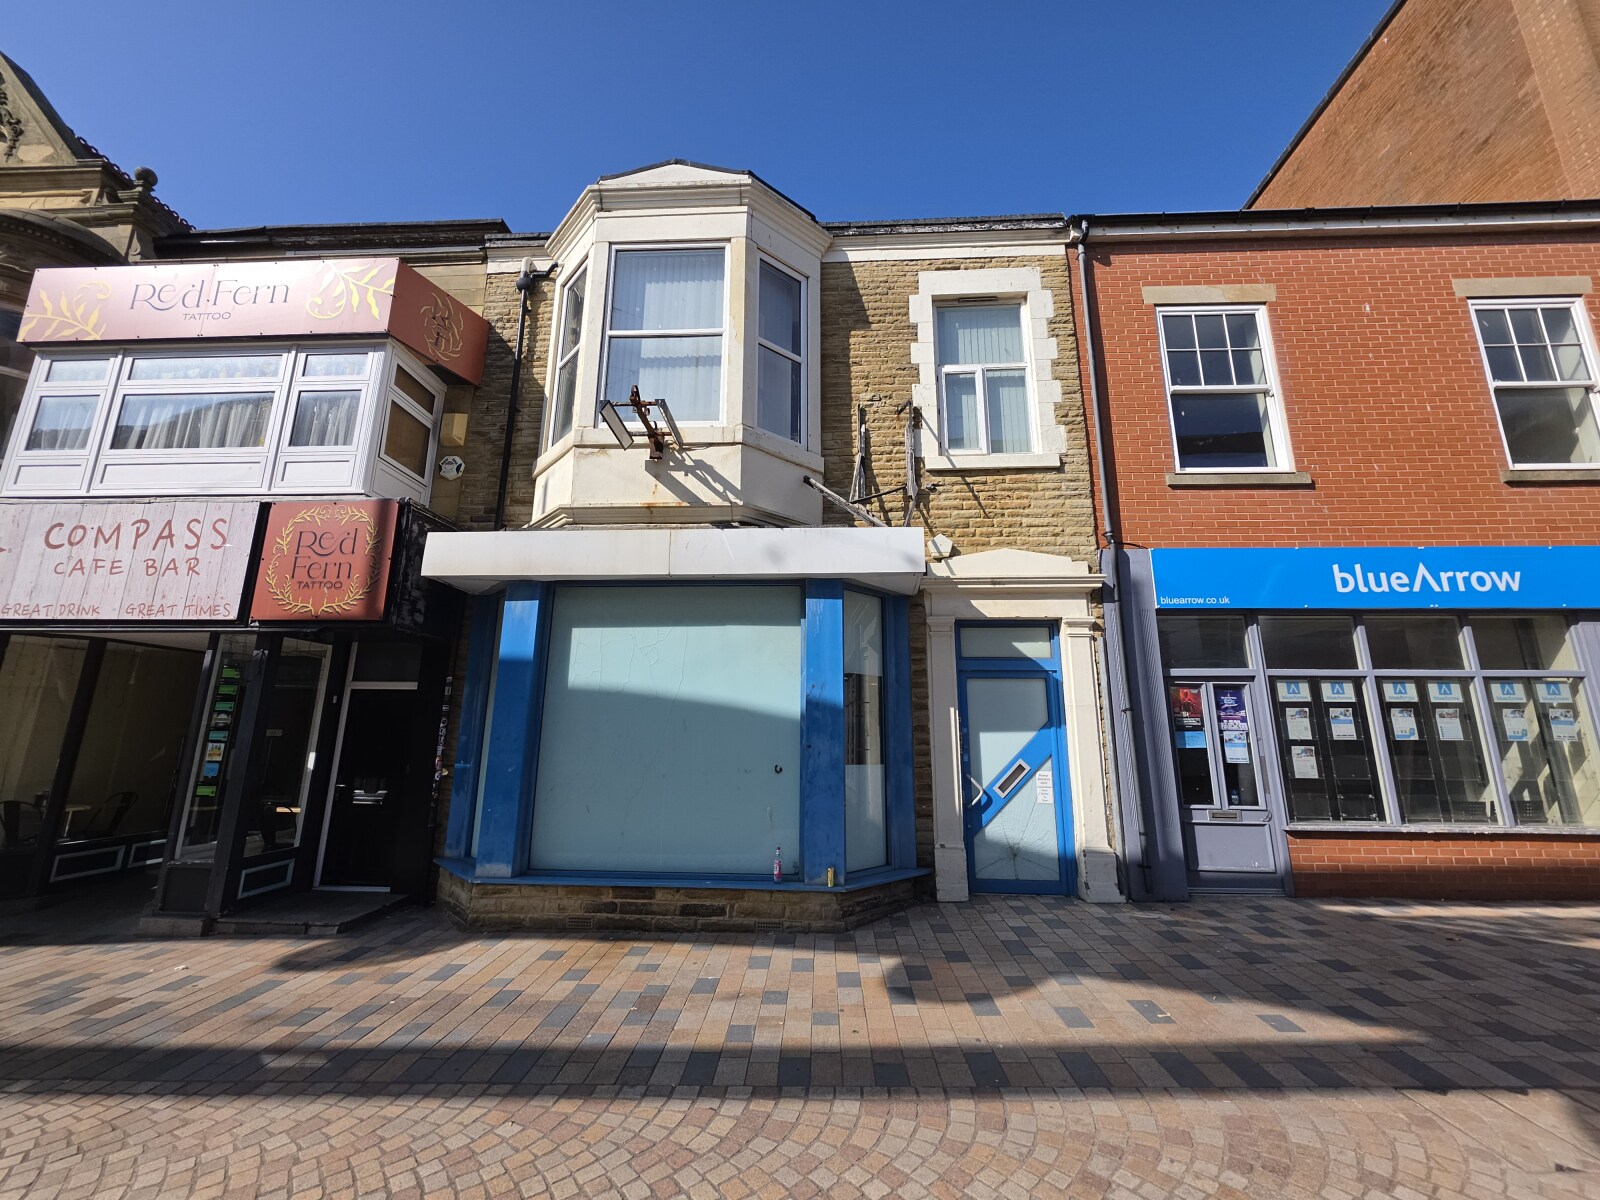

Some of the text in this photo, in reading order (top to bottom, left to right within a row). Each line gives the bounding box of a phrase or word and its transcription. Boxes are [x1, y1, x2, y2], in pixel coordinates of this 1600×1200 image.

[130, 279, 289, 311] Red Fern
[182, 311, 231, 321] TATTOO
[44, 518, 228, 551] COMPASS
[295, 527, 358, 557] Red
[53, 556, 201, 577] CAFE BAR
[291, 555, 352, 580] Fern
[1332, 561, 1521, 593] blueArrow
[296, 580, 343, 590] TATTOO
[0, 603, 102, 617] GREAT DRINK
[125, 602, 232, 617] GREAT TIMES
[1160, 595, 1231, 605] bluearrow.co.uk
